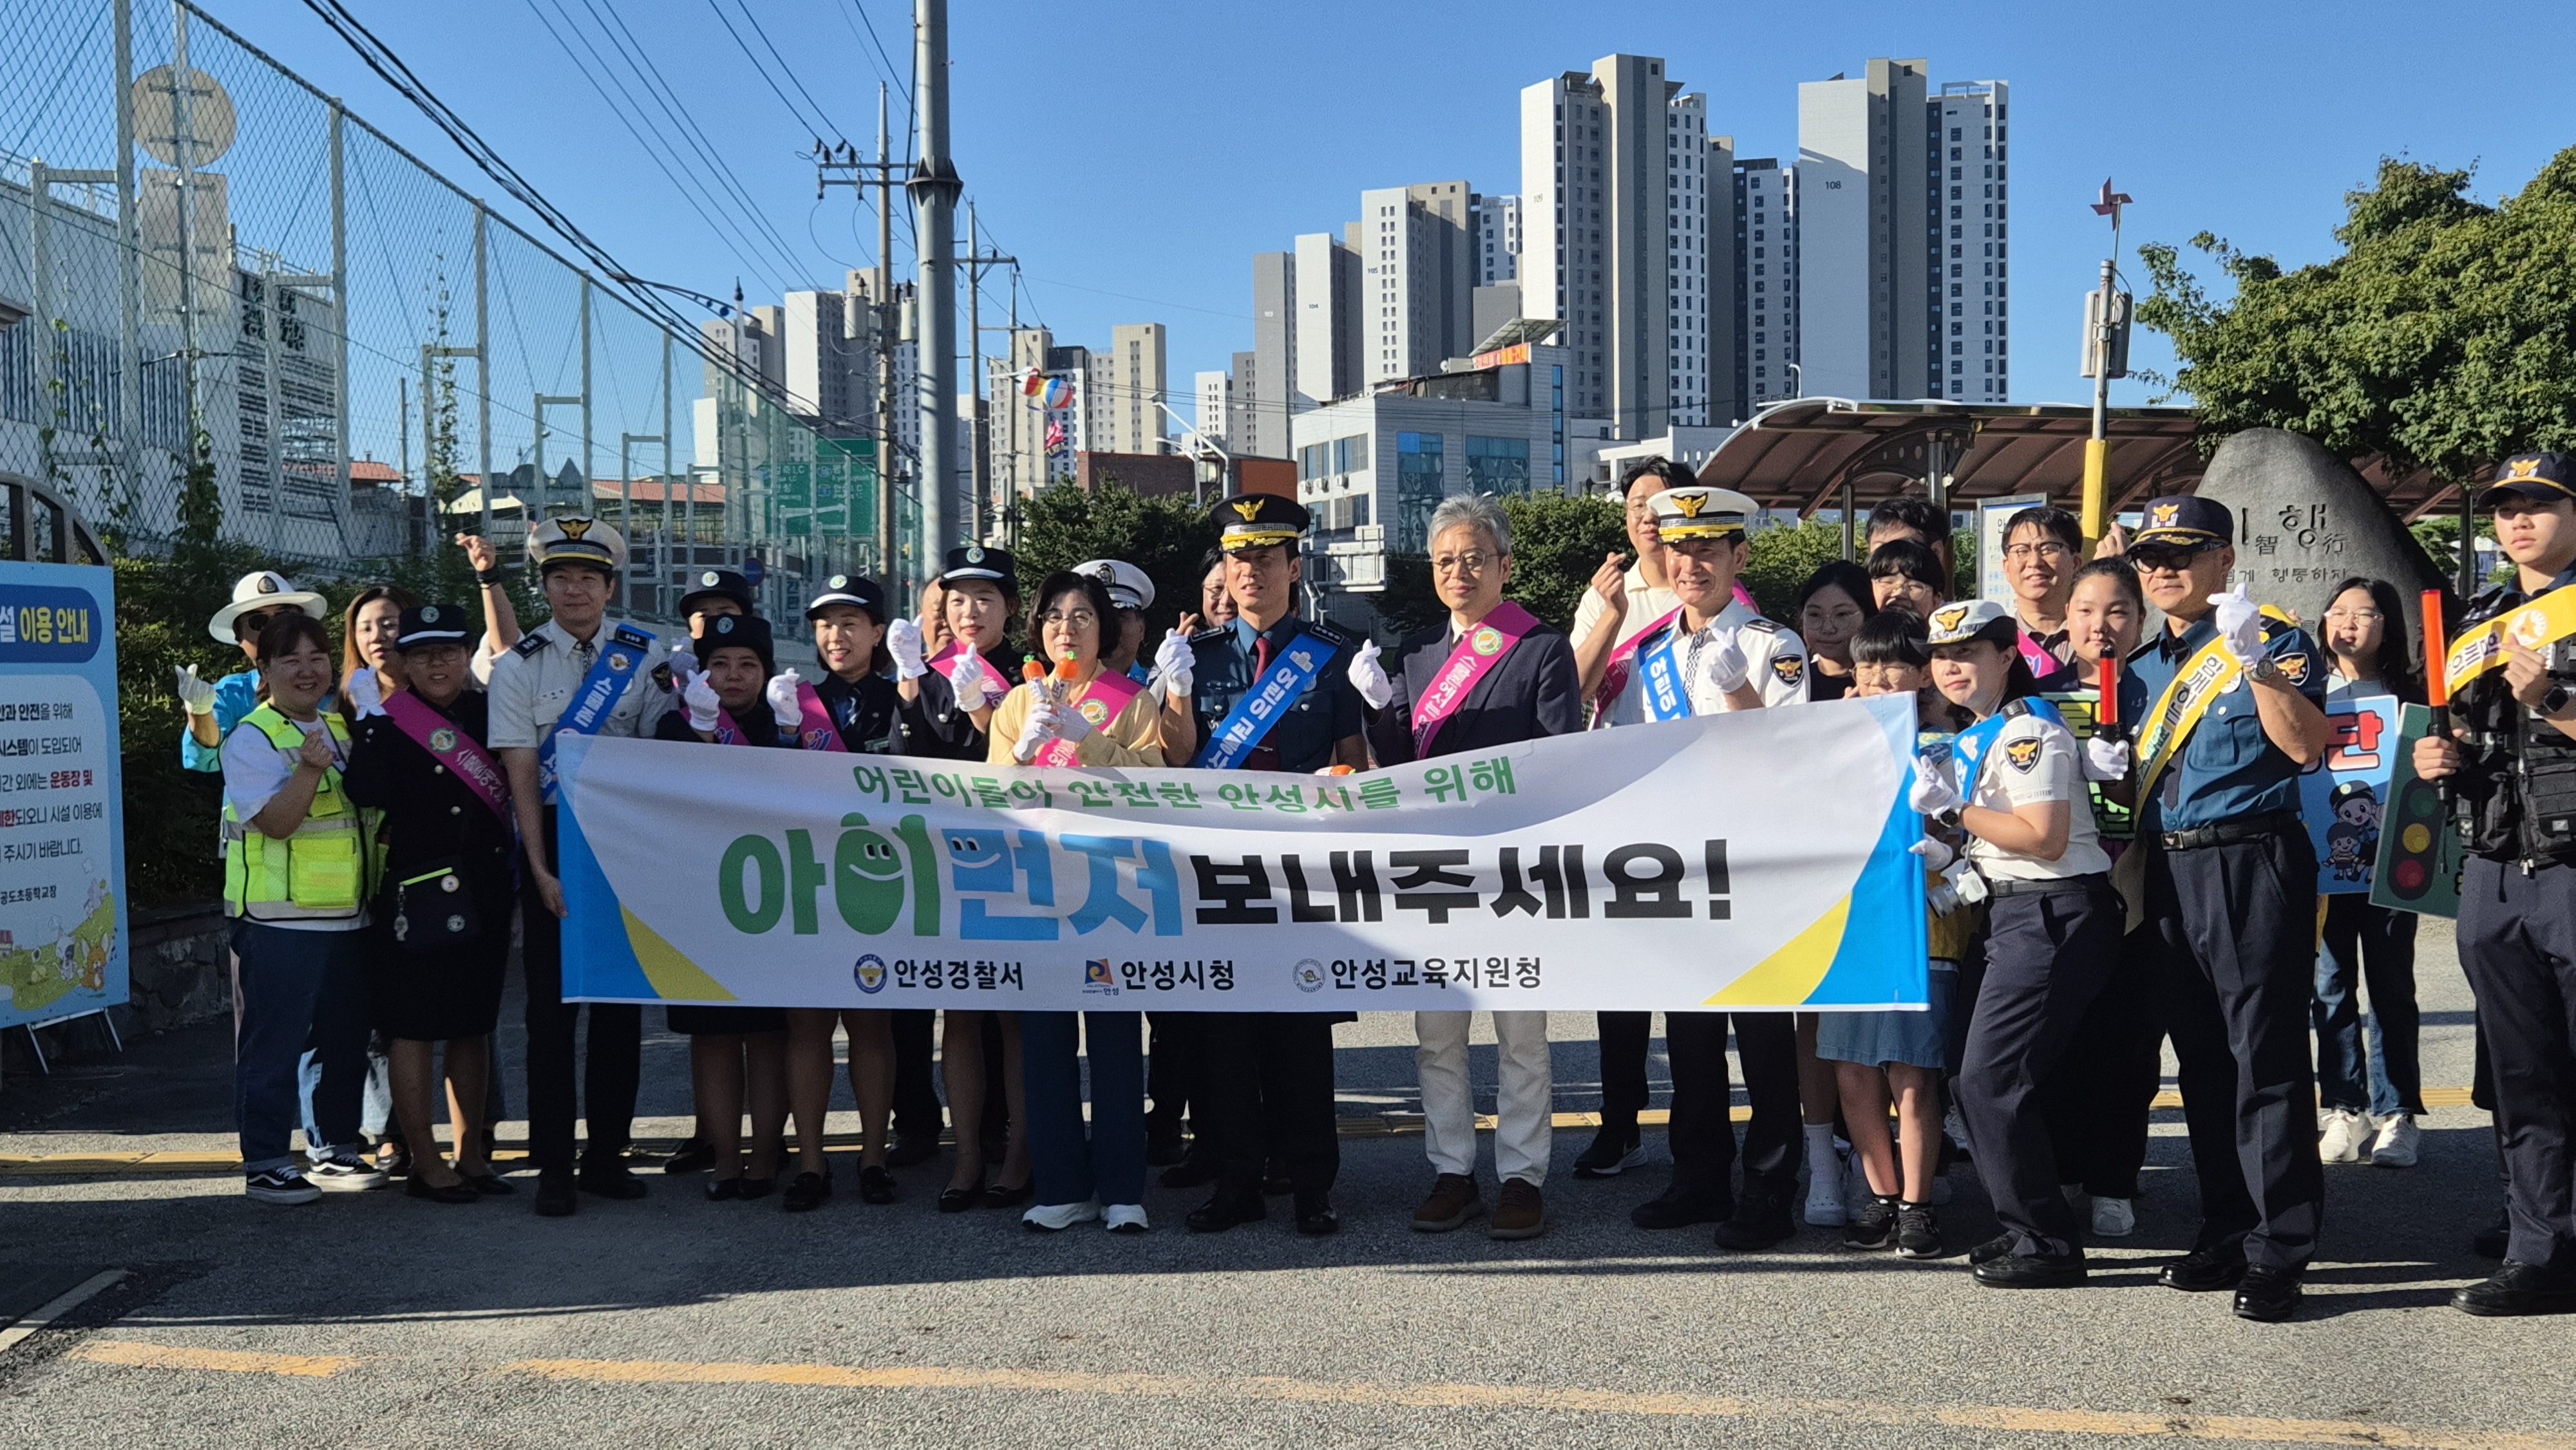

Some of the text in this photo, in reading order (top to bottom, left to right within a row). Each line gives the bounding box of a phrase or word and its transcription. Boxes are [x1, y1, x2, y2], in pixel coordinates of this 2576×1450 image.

[1825, 180, 1842, 190] 108
[2323, 533, 2348, 554] 行
[20, 607, 53, 643] 이용
[56, 608, 89, 643] 안내
[1425, 655, 1478, 719] 스쿨존에서는
[1650, 655, 1677, 713] 어린이
[19, 702, 50, 722] 안전을
[53, 702, 73, 720] 위해
[1205, 667, 1299, 769] 어린이 교통사
[41, 735, 82, 755] 도입되어
[16, 772, 48, 791] 외에는
[50, 769, 80, 789] 운동장
[83, 769, 93, 787] 및
[853, 756, 1516, 814] 어린이들이 안전한 안성시를 위해
[50, 805, 71, 823] 시설
[73, 802, 102, 821] 이용에
[4, 837, 84, 863] 주시기 바랍니다.
[894, 959, 1024, 991] 안성경찰서
[1121, 959, 1235, 991] 안성시청
[1331, 957, 1541, 990] 안성교육지원청
[1103, 987, 1119, 995] 안성
